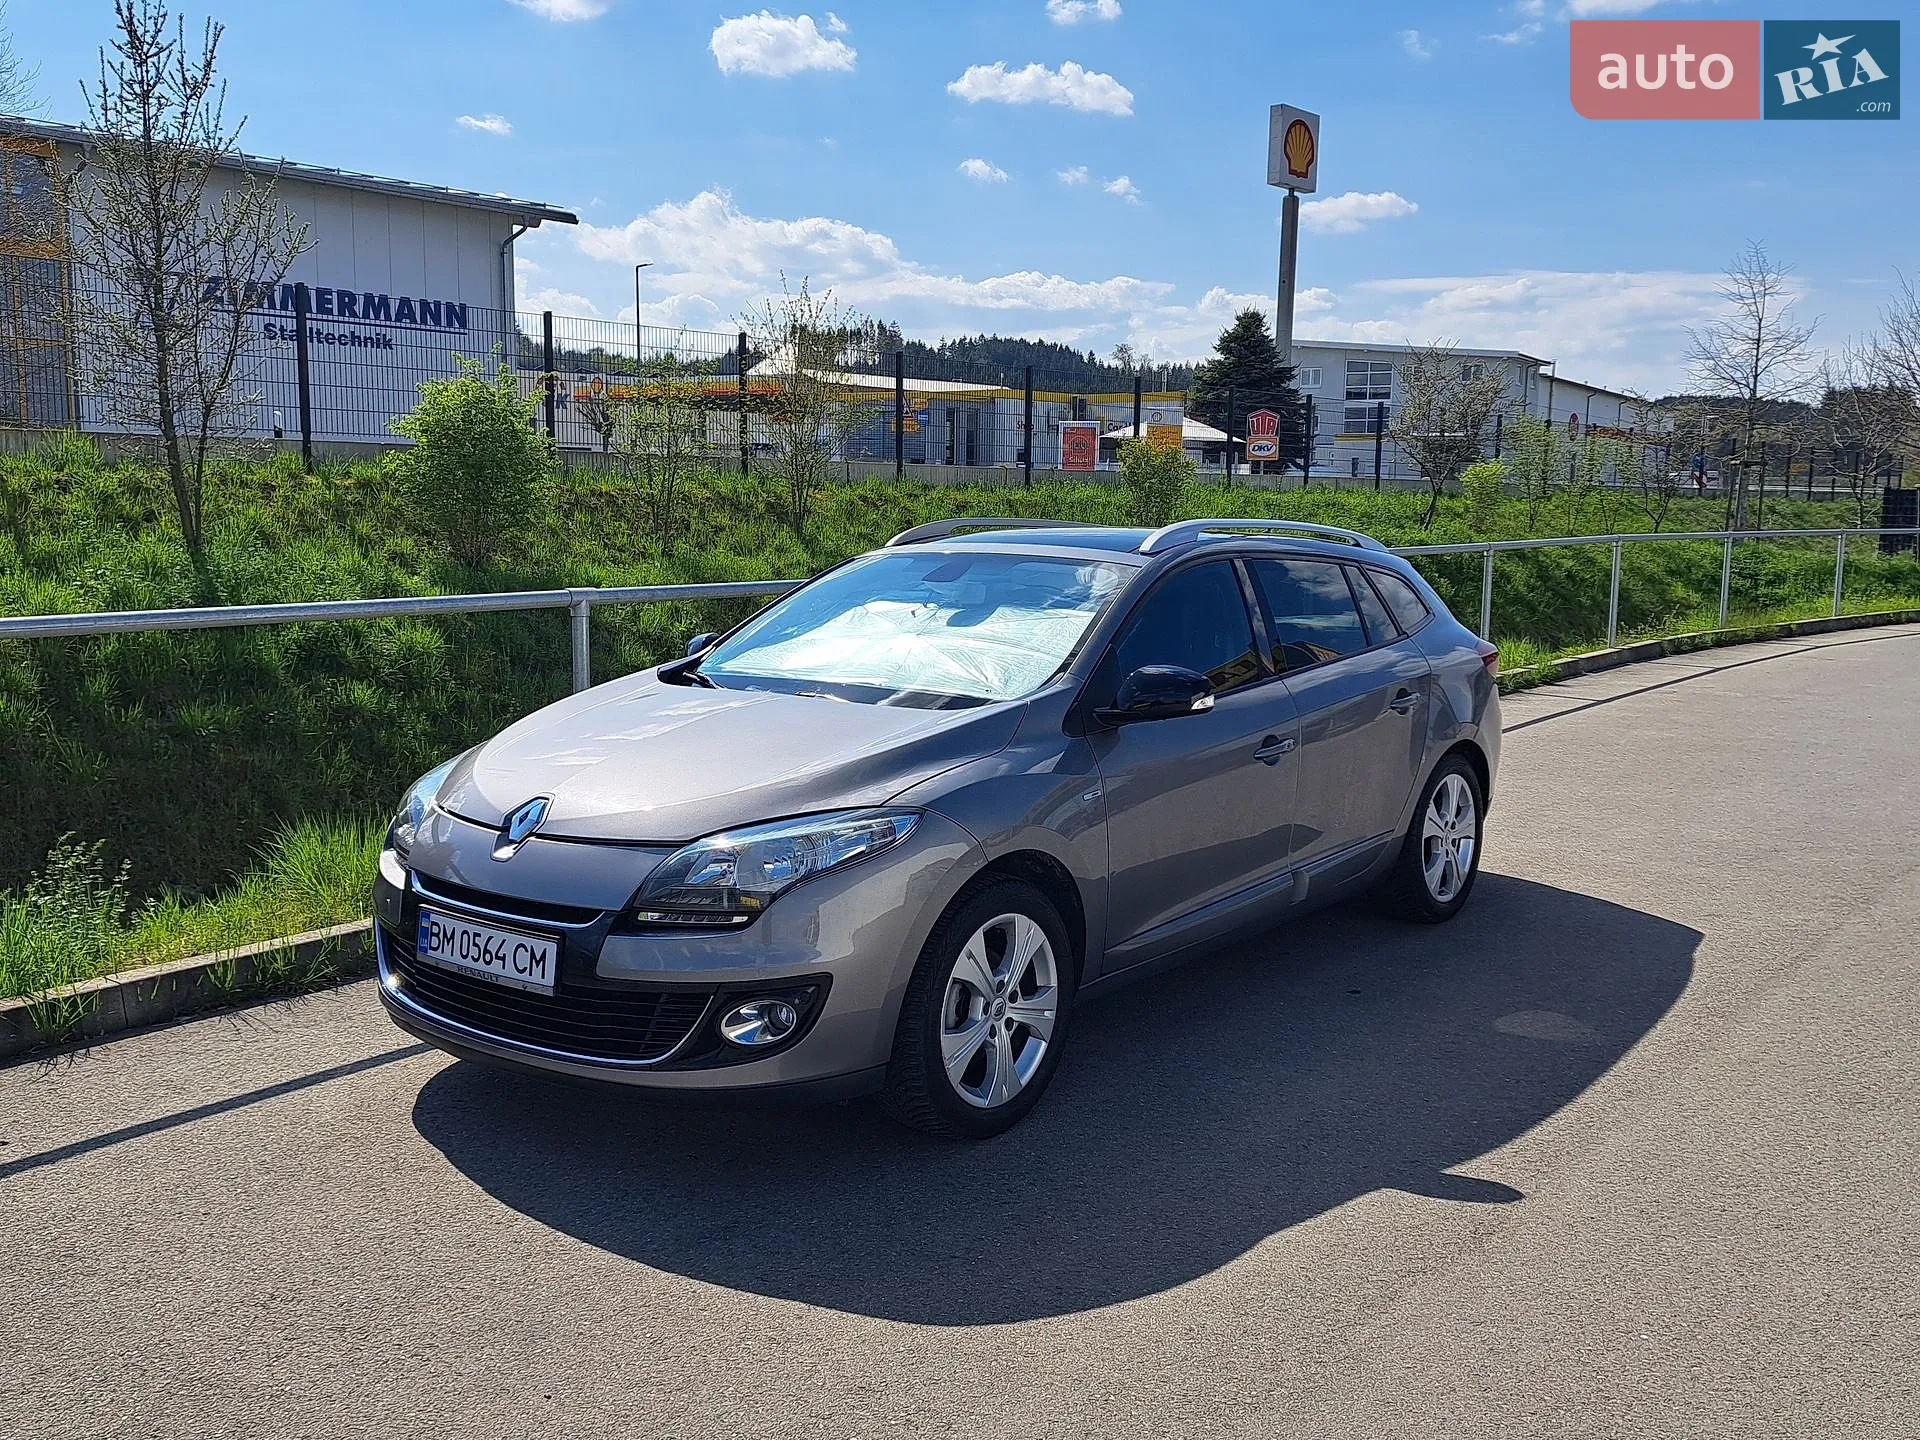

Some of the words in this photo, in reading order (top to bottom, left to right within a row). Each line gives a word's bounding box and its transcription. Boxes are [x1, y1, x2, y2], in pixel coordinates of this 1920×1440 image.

[204, 276, 467, 328] ZMMERMANN
[263, 322, 394, 350] Staltechnik
[1016, 420, 1035, 431] Shp
[1249, 412, 1278, 436] UTA
[429, 921, 456, 957] BM
[460, 929, 507, 970] 0564
[512, 943, 547, 979] CM
[457, 966, 499, 982] RENAULT
